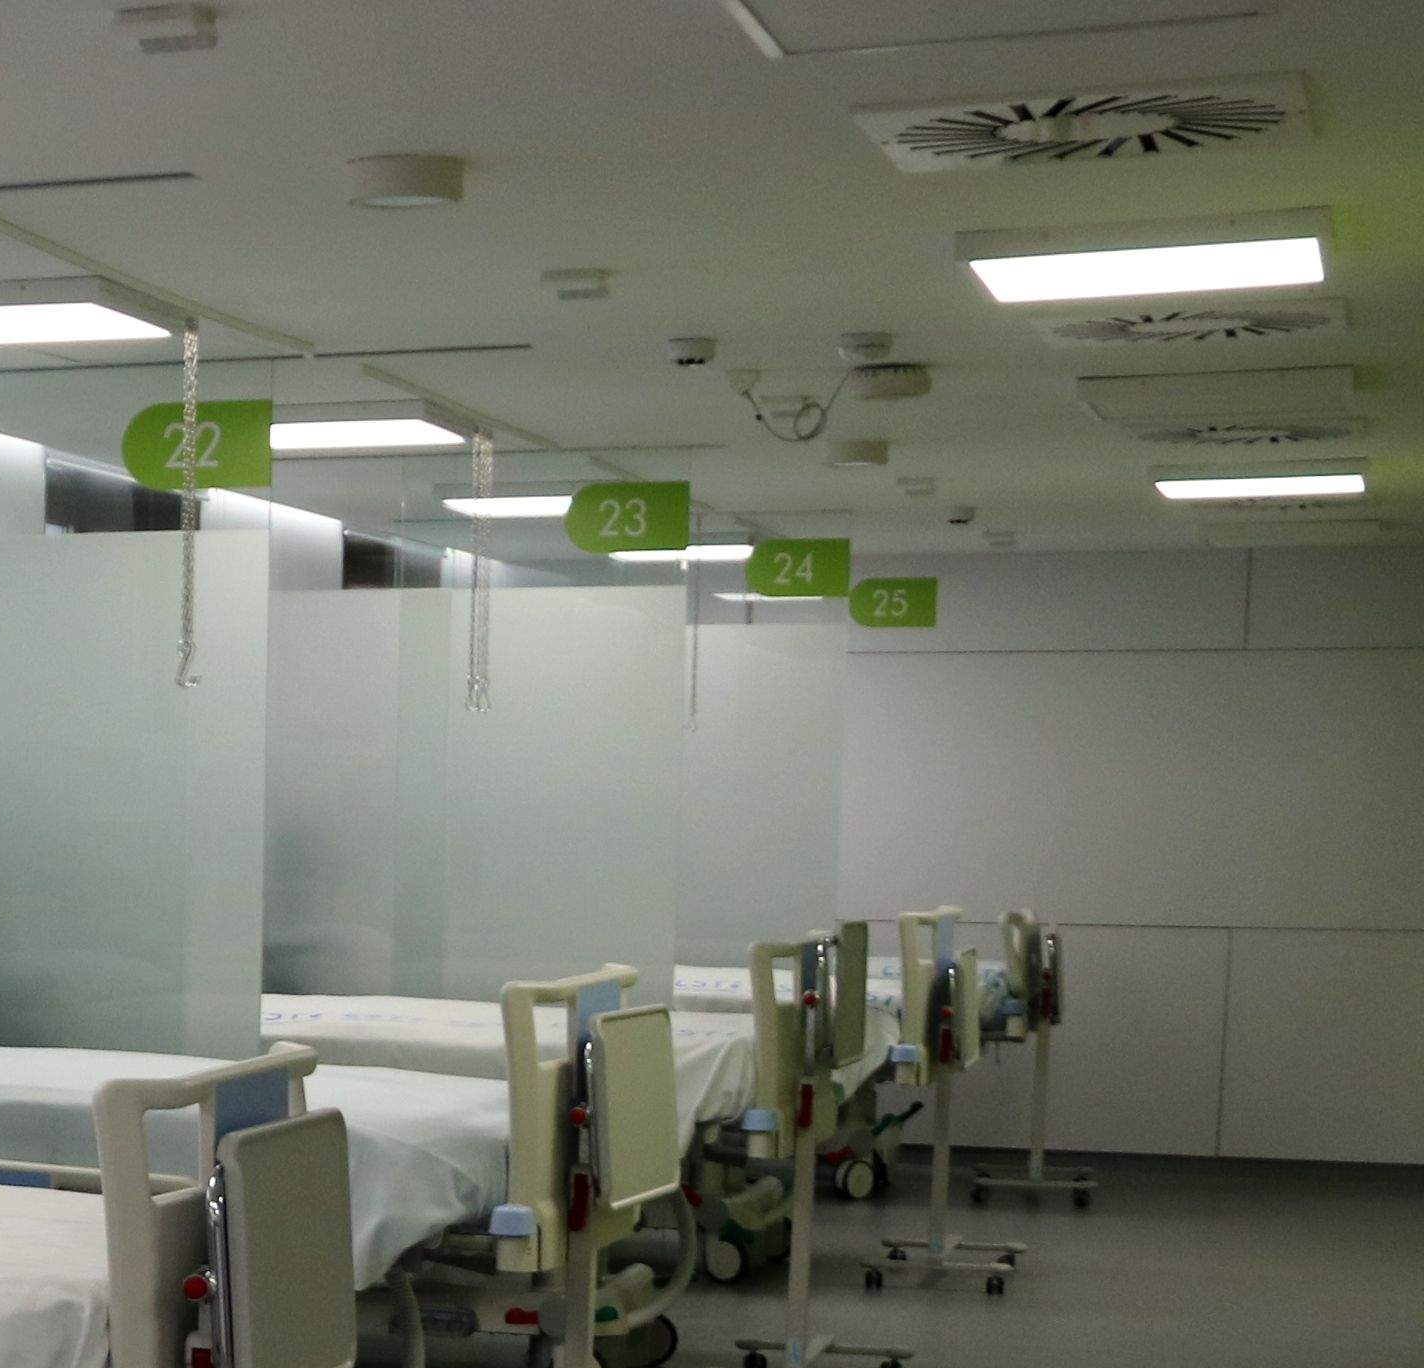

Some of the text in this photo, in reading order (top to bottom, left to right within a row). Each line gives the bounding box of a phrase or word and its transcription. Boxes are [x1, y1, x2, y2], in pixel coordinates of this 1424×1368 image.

[163, 421, 220, 469] 22
[598, 499, 647, 537] 23
[773, 552, 813, 584] 24
[872, 589, 908, 617] 25
